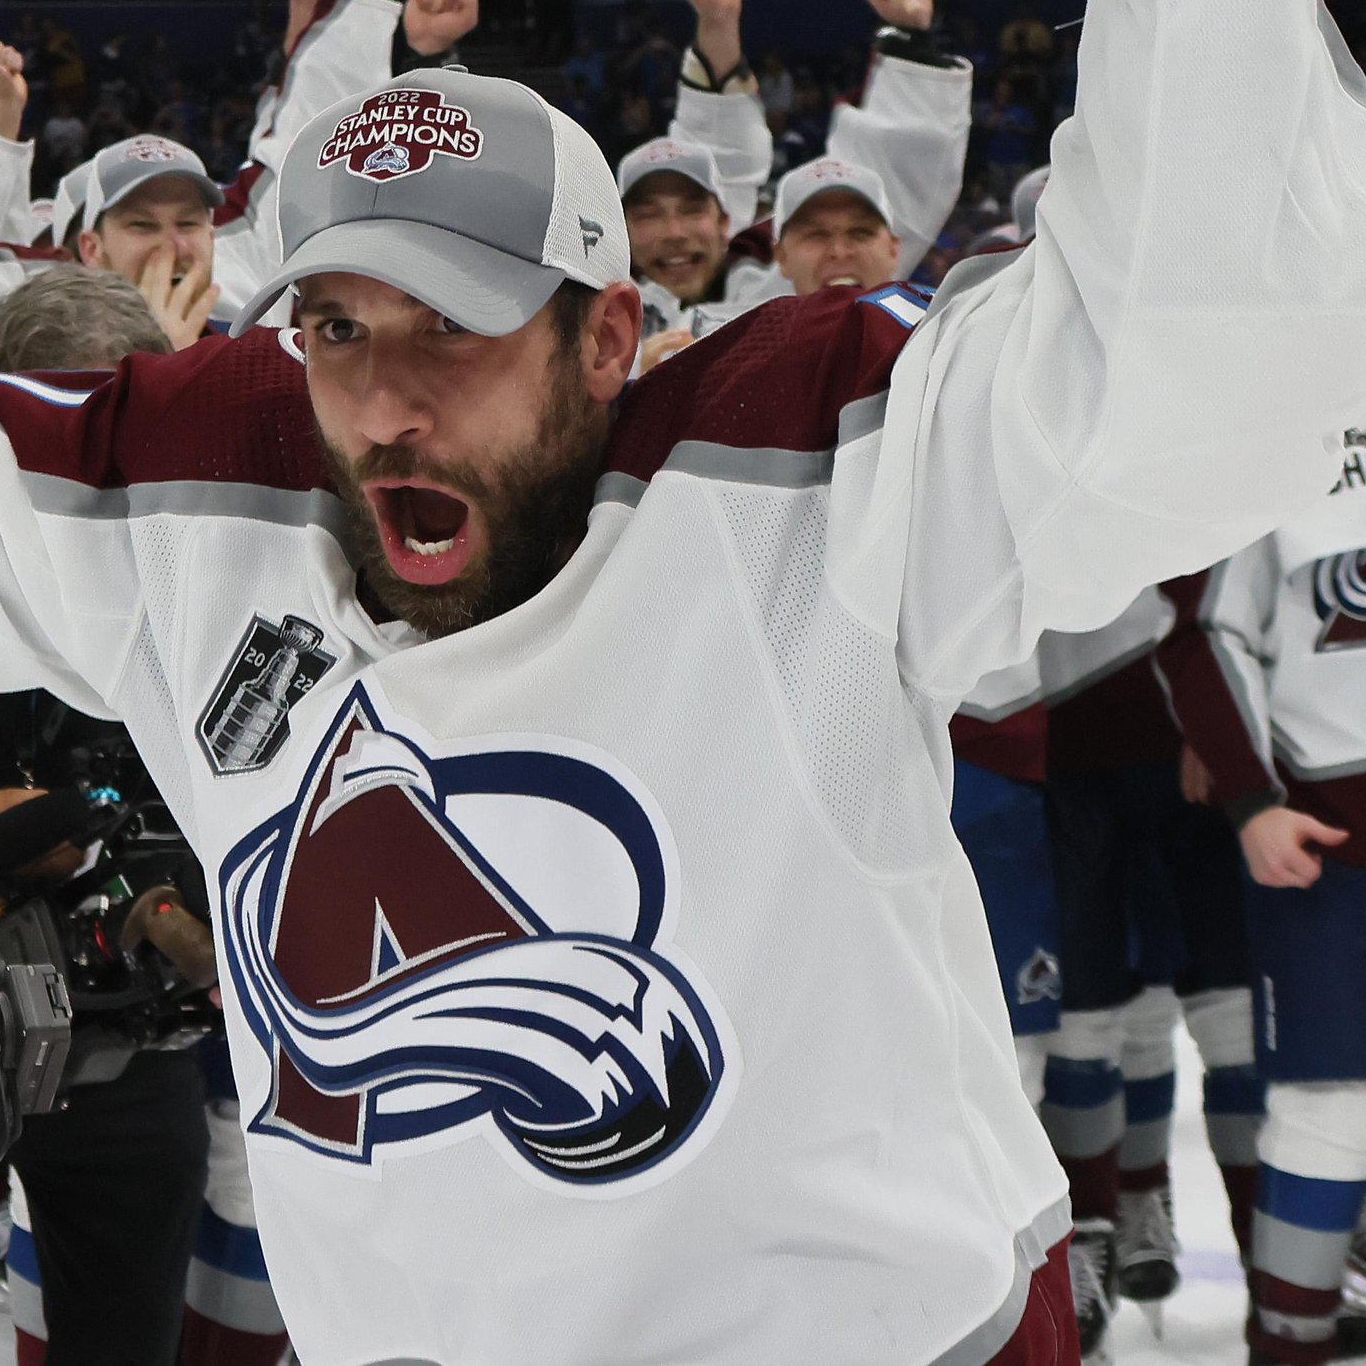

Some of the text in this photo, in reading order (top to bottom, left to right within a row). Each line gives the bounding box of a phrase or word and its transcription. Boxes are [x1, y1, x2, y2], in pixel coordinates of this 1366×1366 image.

[377, 91, 421, 106] 2022
[338, 104, 464, 135] STANLEY CUP
[321, 125, 477, 161] CHAMPIONS
[244, 647, 266, 668] 20
[294, 673, 315, 695] 22
